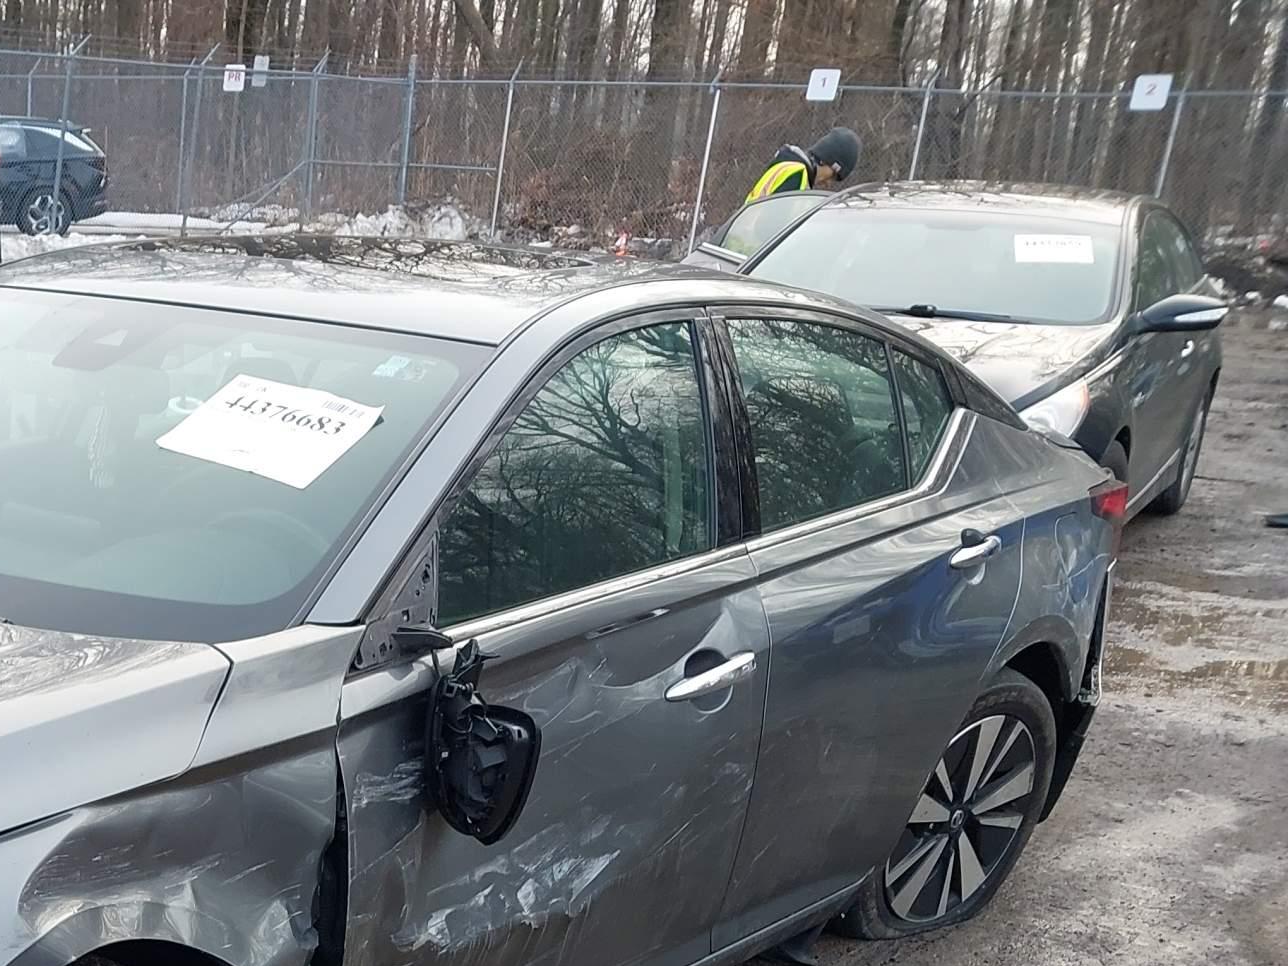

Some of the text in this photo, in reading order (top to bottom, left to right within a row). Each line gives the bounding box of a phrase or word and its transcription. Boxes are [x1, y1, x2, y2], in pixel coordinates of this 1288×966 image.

[228, 72, 241, 81] PR
[1145, 83, 1159, 96] 2
[225, 396, 346, 435] 44376683
